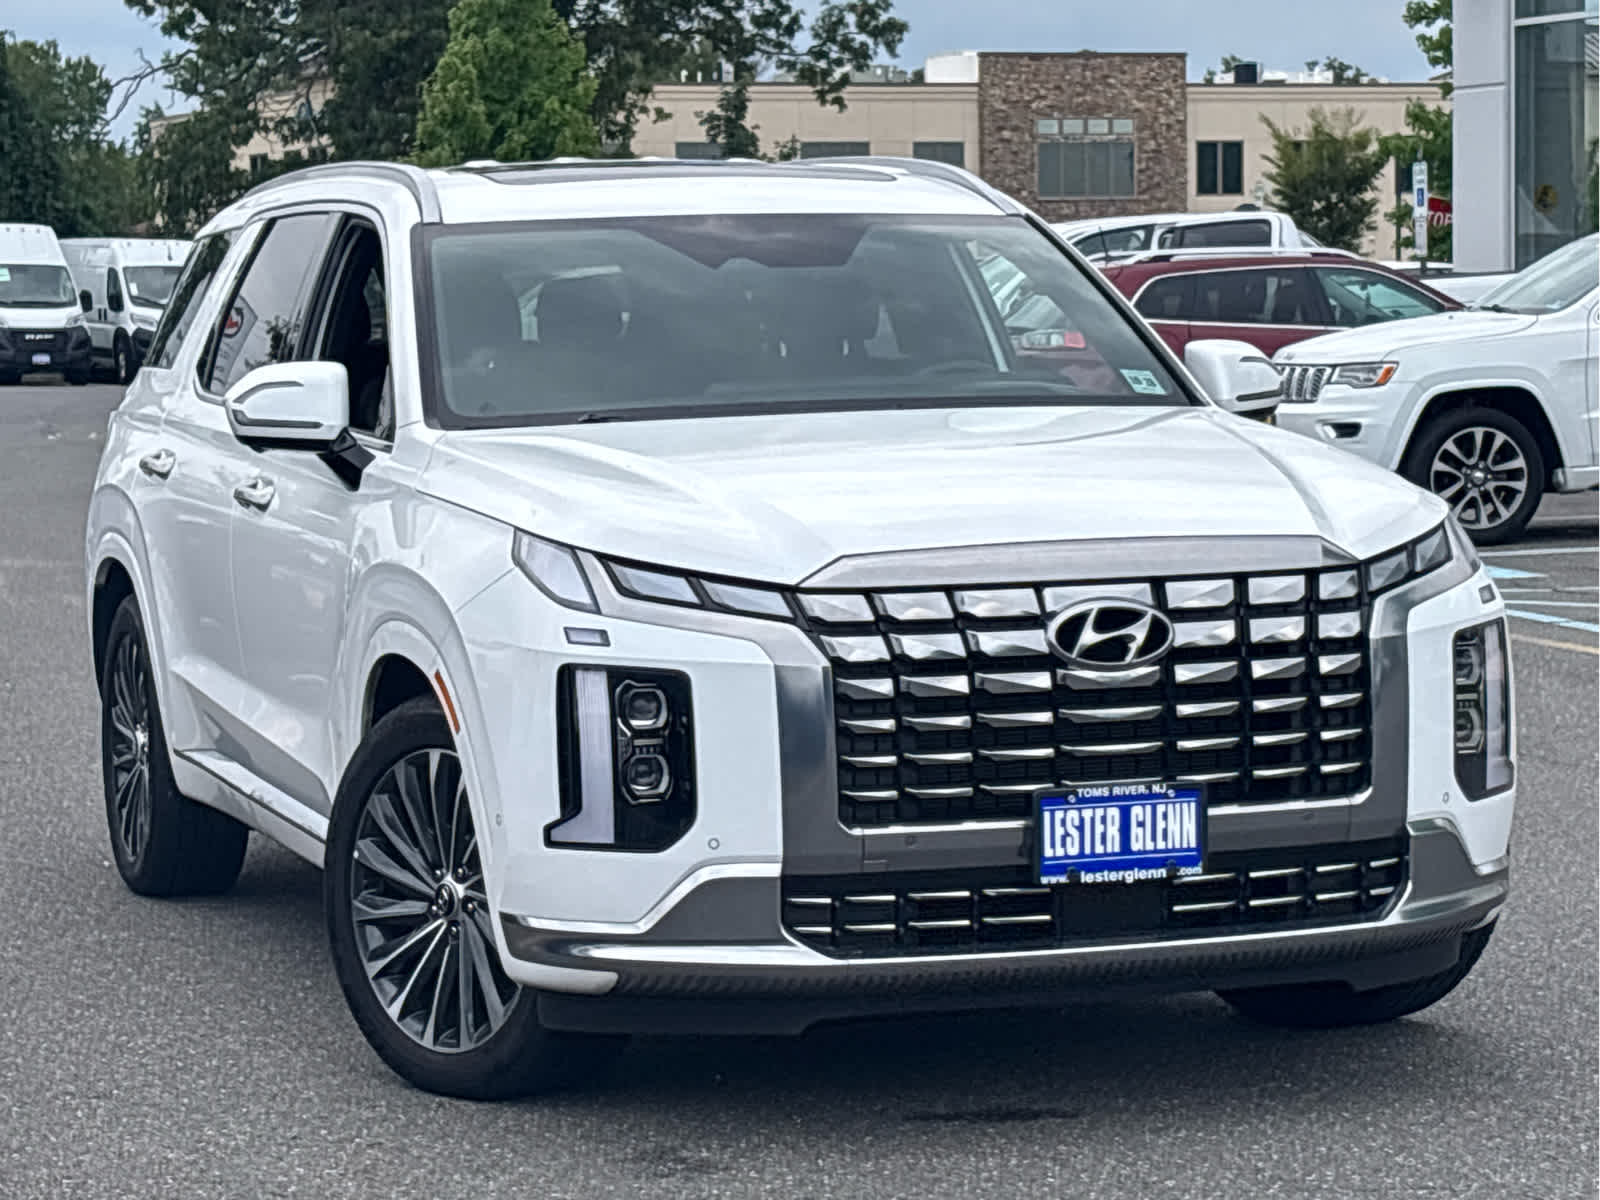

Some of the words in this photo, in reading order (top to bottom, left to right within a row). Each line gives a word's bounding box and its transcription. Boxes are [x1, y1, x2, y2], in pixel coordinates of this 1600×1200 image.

[1427, 211, 1453, 226] TOP
[1076, 786, 1110, 798] TOMS
[1043, 807, 1121, 858] LESTER
[1130, 802, 1197, 852] GLENN
[1080, 866, 1167, 884] lesterglenn
